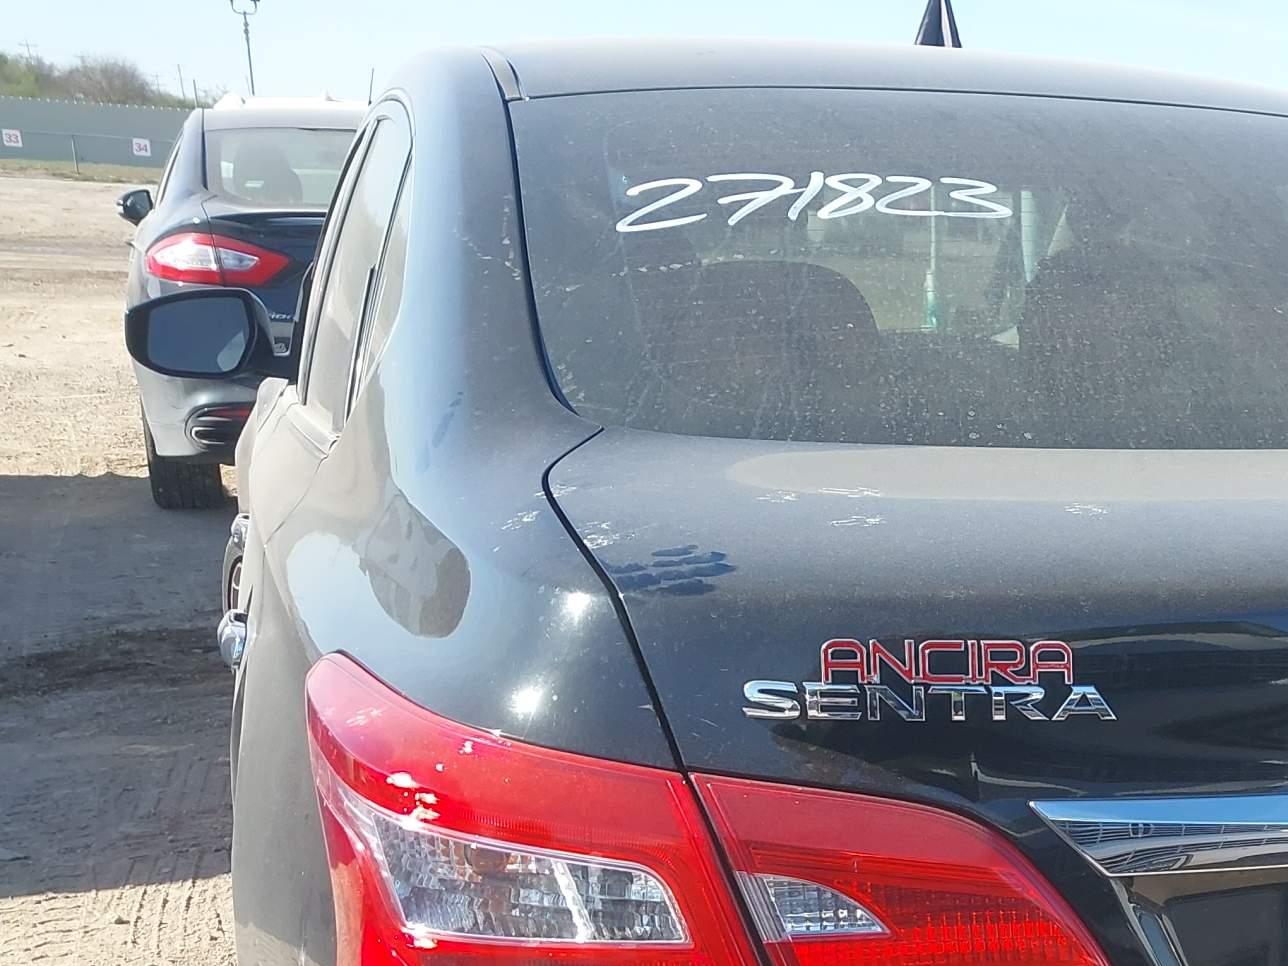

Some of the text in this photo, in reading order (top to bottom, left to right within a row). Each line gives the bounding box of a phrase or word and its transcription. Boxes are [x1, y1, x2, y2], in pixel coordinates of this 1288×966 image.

[4, 132, 20, 144] 33
[134, 142, 149, 153] 34
[615, 171, 1014, 233] 271823
[820, 638, 1074, 685] ANCIRA
[741, 679, 1118, 722] SENTRA
